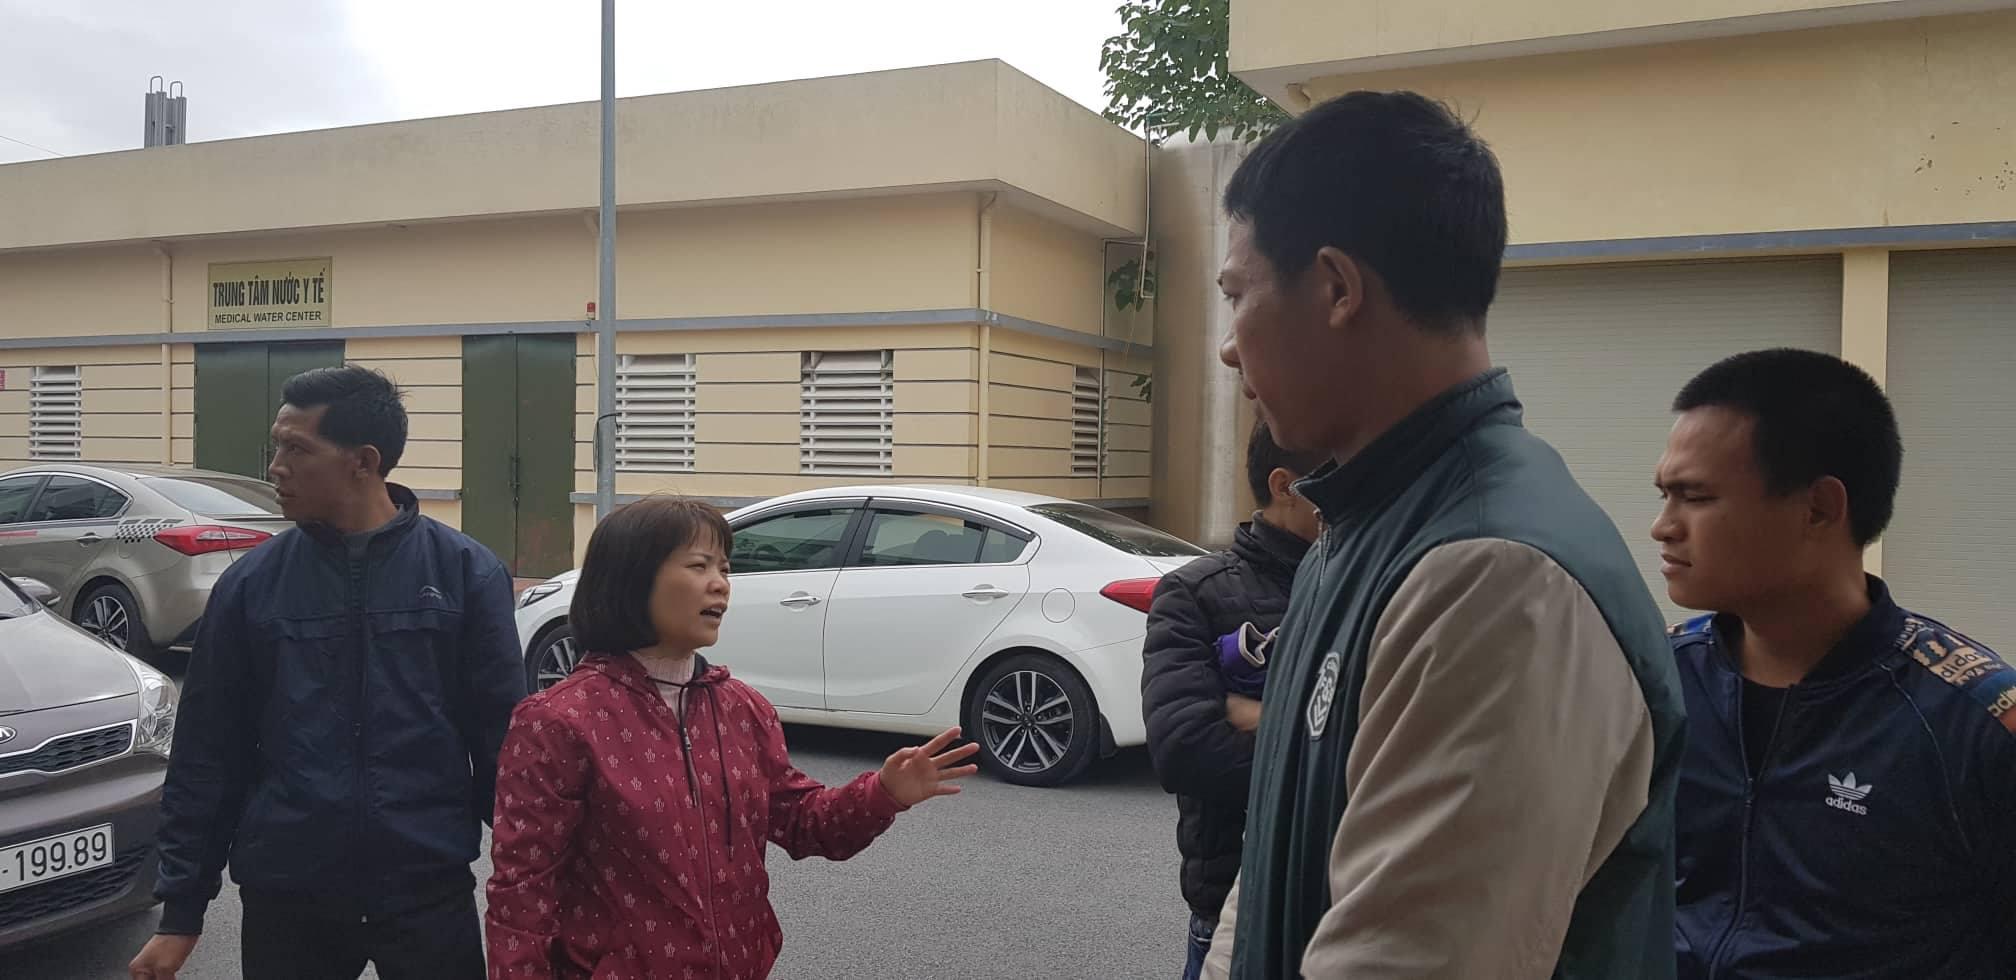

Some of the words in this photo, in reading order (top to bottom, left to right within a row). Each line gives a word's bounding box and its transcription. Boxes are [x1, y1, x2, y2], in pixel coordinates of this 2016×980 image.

[213, 281, 245, 307] TRUNG
[248, 274, 269, 306] TÂM
[303, 278, 309, 304] Y
[312, 267, 326, 304] TẾ
[215, 313, 251, 324] MEDICAL
[253, 312, 284, 322] WATER
[285, 311, 322, 321] CENTER
[1825, 797, 1868, 815] adidas
